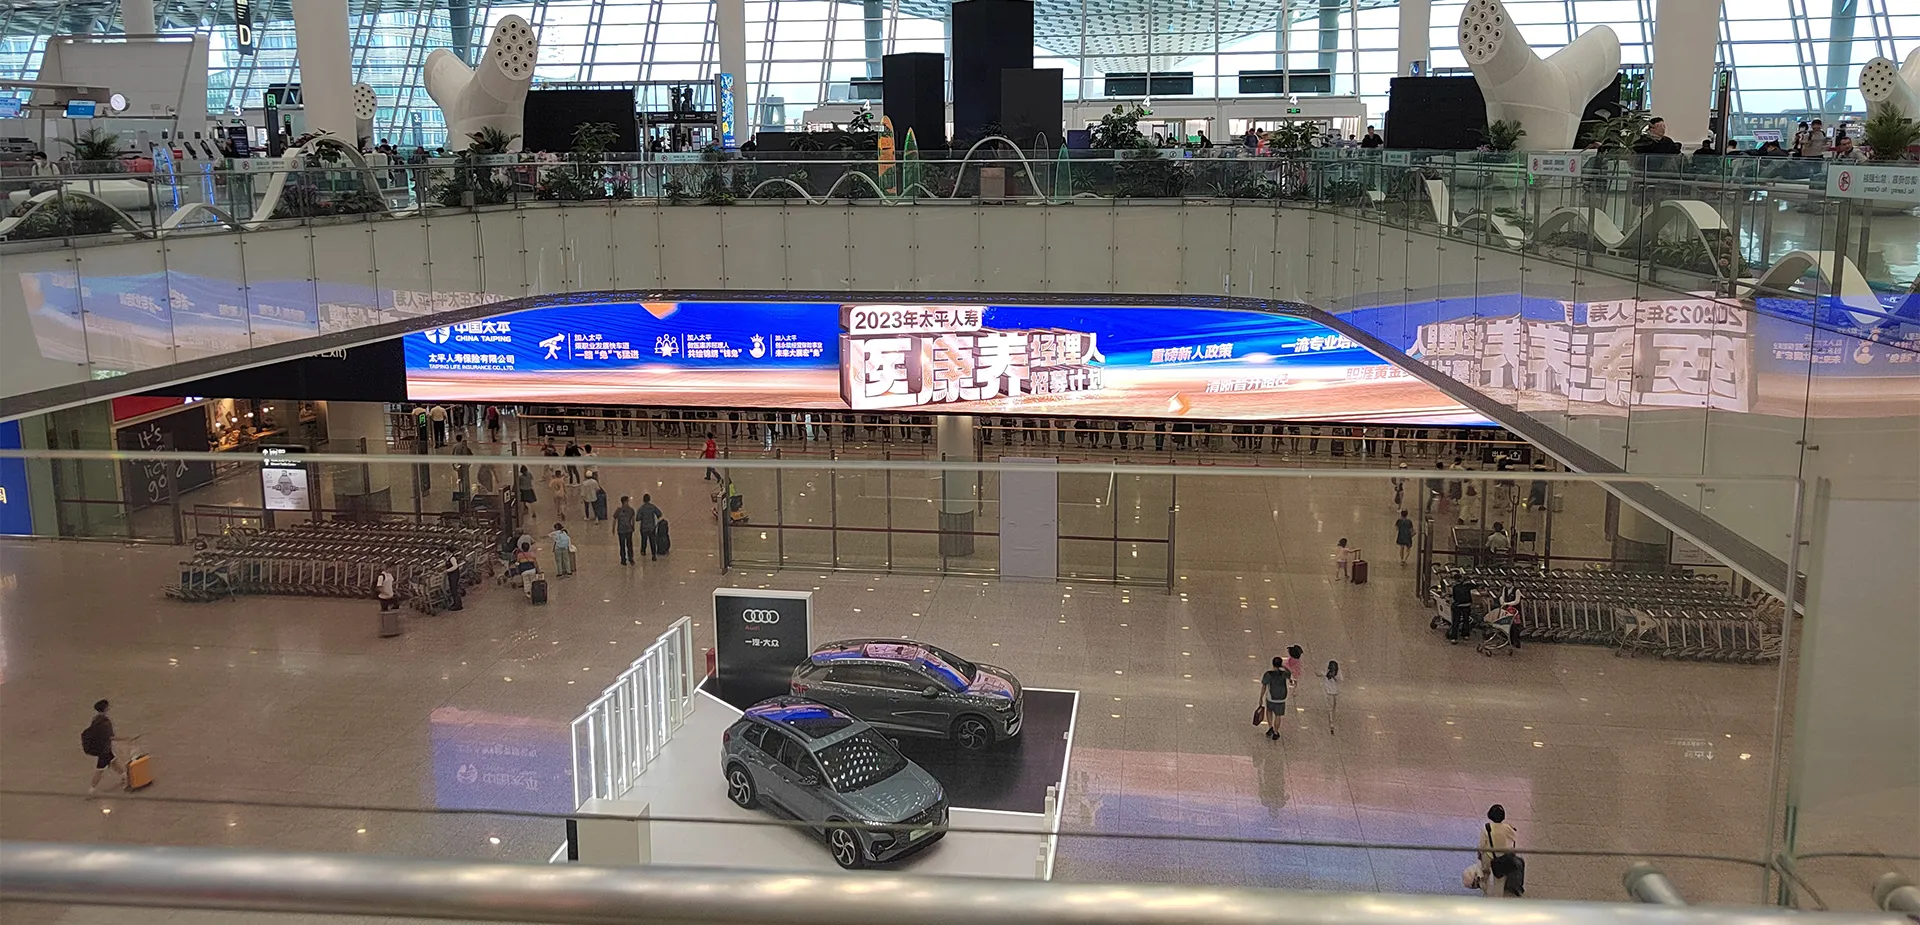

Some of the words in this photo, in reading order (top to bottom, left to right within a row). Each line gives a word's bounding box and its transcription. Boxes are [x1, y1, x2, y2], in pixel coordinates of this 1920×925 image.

[239, 24, 251, 45] D
[863, 100, 871, 111] 4
[1142, 96, 1151, 107] 4
[1290, 96, 1298, 105] 4
[454, 321, 511, 334] 中国太平
[855, 309, 979, 330] 2023年太平人寿
[428, 353, 516, 365] 太平人寿保险有限公司
[1150, 343, 1234, 363] 重磅新人政策
[850, 332, 1030, 410] 医康养
[1029, 332, 1106, 369] 经理人
[1030, 367, 1106, 396] 招募计划
[1205, 373, 1289, 393] 清晰晋升路径
[138, 423, 162, 448] It's
